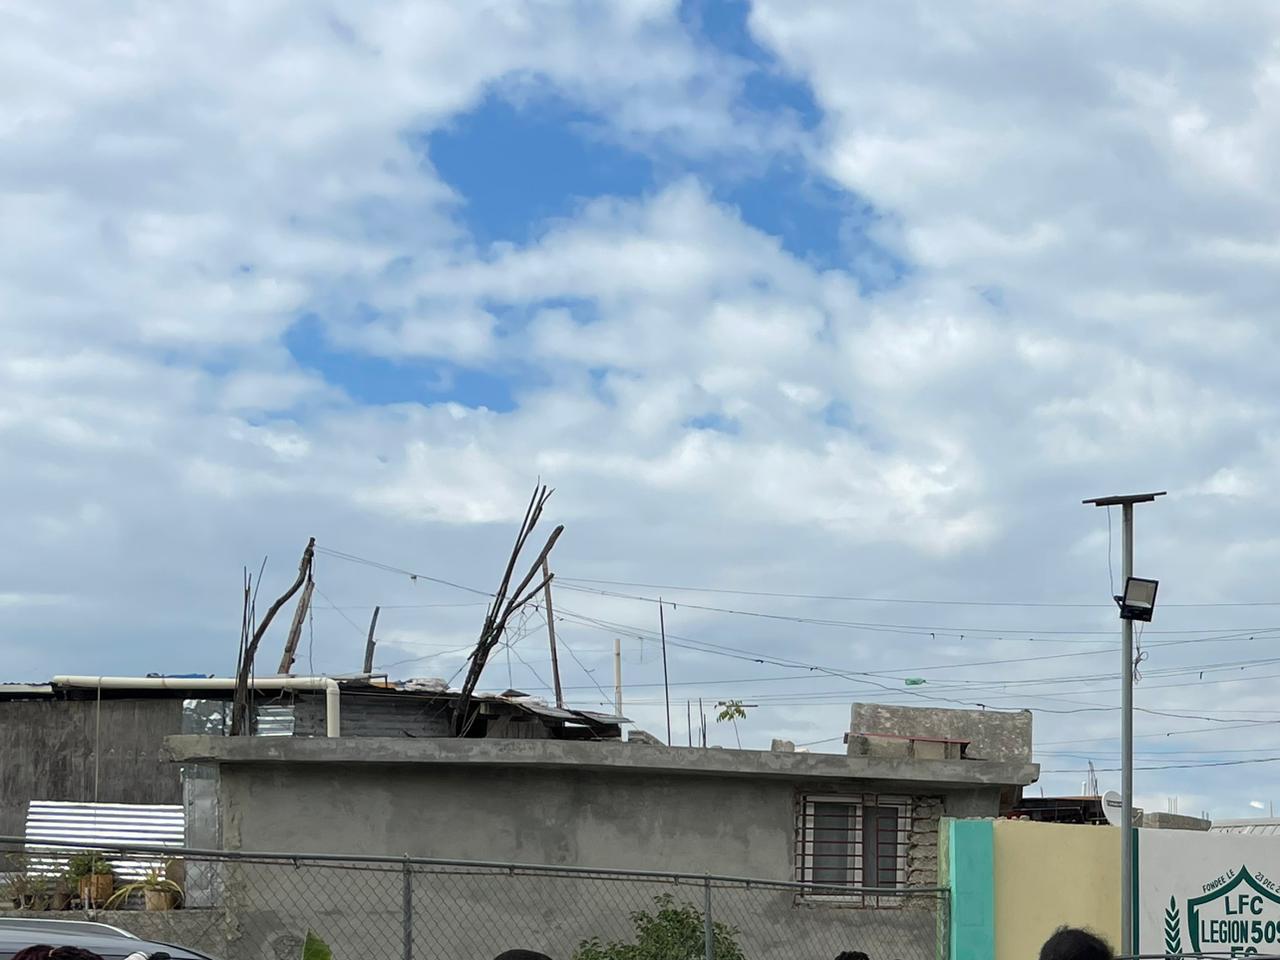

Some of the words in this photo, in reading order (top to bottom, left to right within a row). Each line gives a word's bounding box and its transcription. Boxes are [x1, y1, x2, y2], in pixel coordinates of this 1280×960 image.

[1226, 868, 1236, 880] LE
[1255, 872, 1264, 882] 23
[1225, 894, 1264, 915] LFC
[1201, 919, 1249, 944] LEGION
